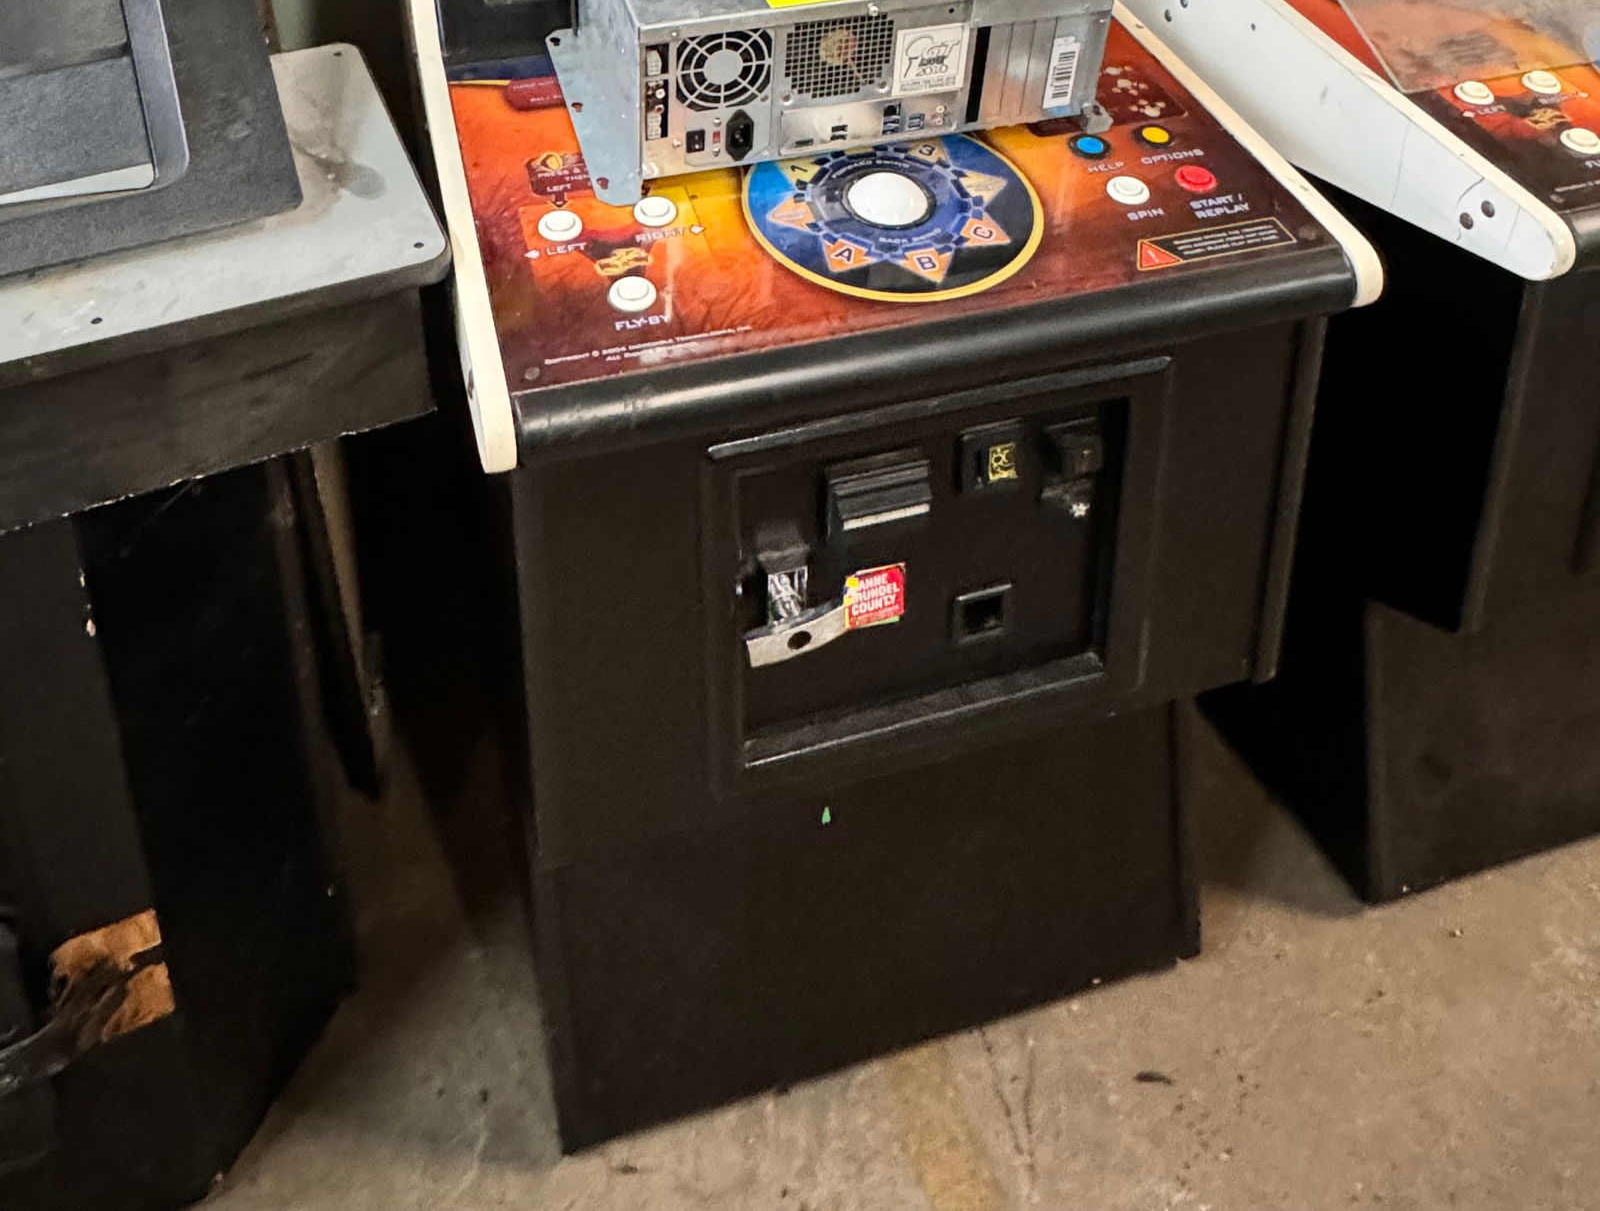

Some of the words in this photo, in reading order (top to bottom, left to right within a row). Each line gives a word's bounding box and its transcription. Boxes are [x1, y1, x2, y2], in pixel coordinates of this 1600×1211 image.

[919, 143, 937, 157] 3
[1140, 148, 1205, 165] OPTIONS
[1088, 160, 1125, 173] HELP
[547, 183, 572, 192] LEFT
[1190, 194, 1235, 209] START
[1126, 207, 1165, 221] SPIN
[1193, 202, 1250, 219] REPLAY
[635, 226, 687, 243] RIGHT
[972, 225, 994, 240] C
[546, 241, 588, 256] LEFT
[834, 246, 854, 264] A
[916, 254, 937, 272] B
[614, 313, 671, 332] FLY-BY
[859, 573, 888, 591] ANNE
[849, 582, 900, 603] RUNDEL
[851, 594, 897, 617] COUNTY
